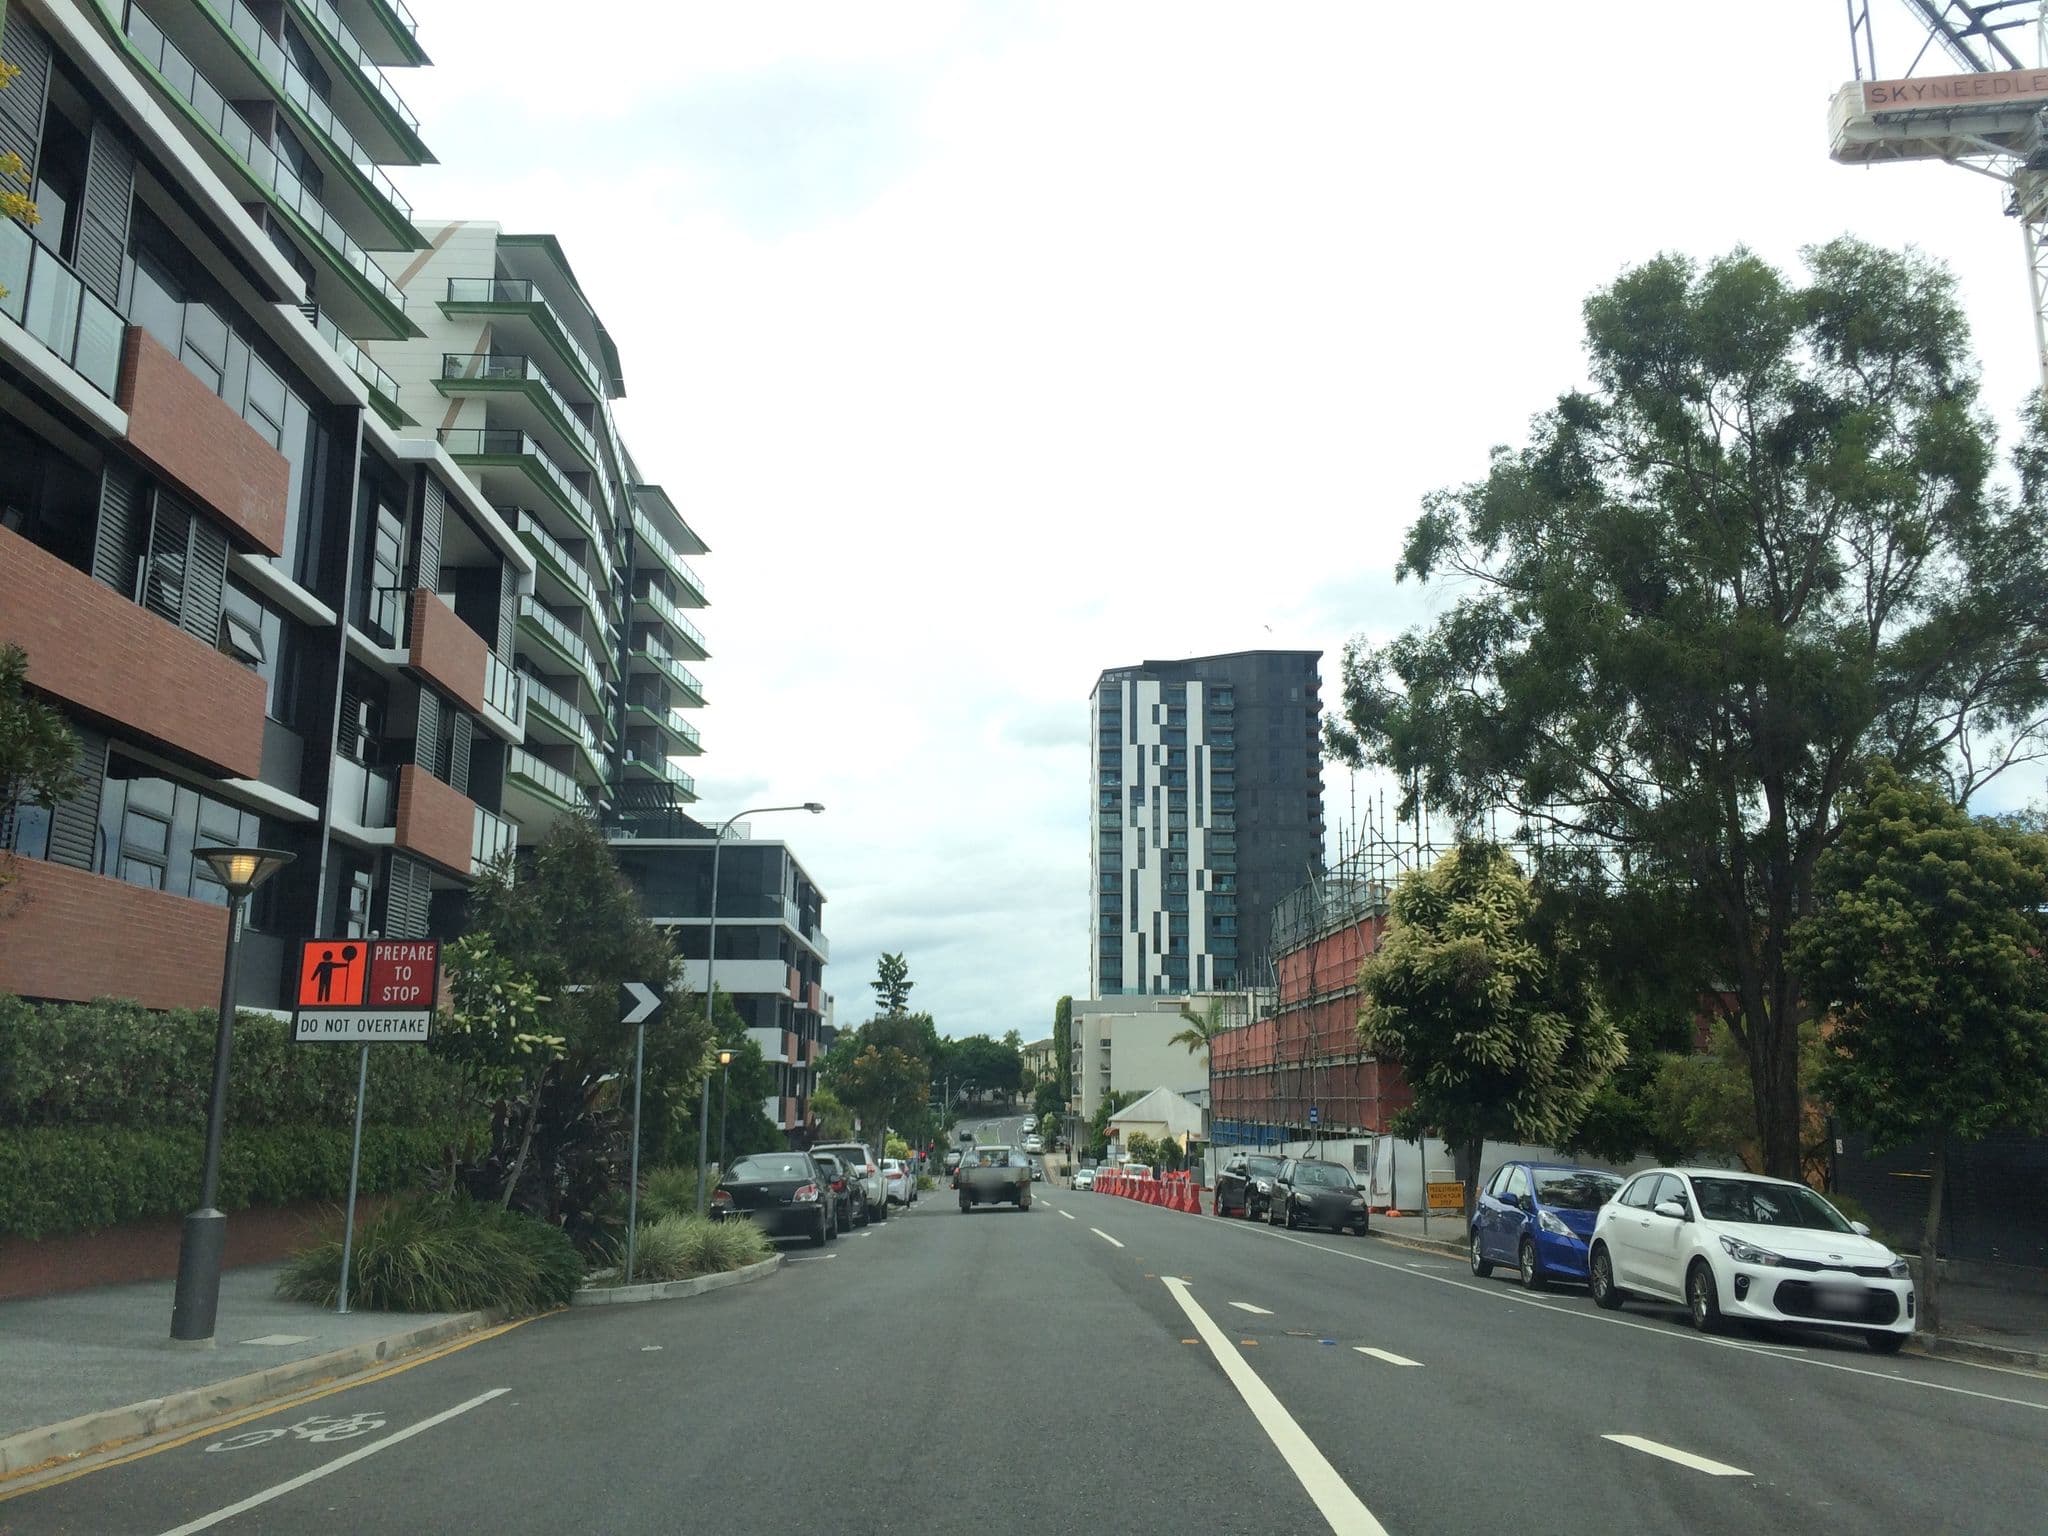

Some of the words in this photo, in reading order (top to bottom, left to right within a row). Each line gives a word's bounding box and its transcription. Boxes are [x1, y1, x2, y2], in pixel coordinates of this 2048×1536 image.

[1871, 75, 2048, 104] SKYNEEDLE
[375, 946, 433, 961] PREPARE
[395, 966, 411, 981] TO
[383, 986, 420, 1001] STOP
[301, 1019, 318, 1033] DO
[325, 1019, 350, 1033] NOT
[357, 1019, 425, 1033] OVERTAKE
